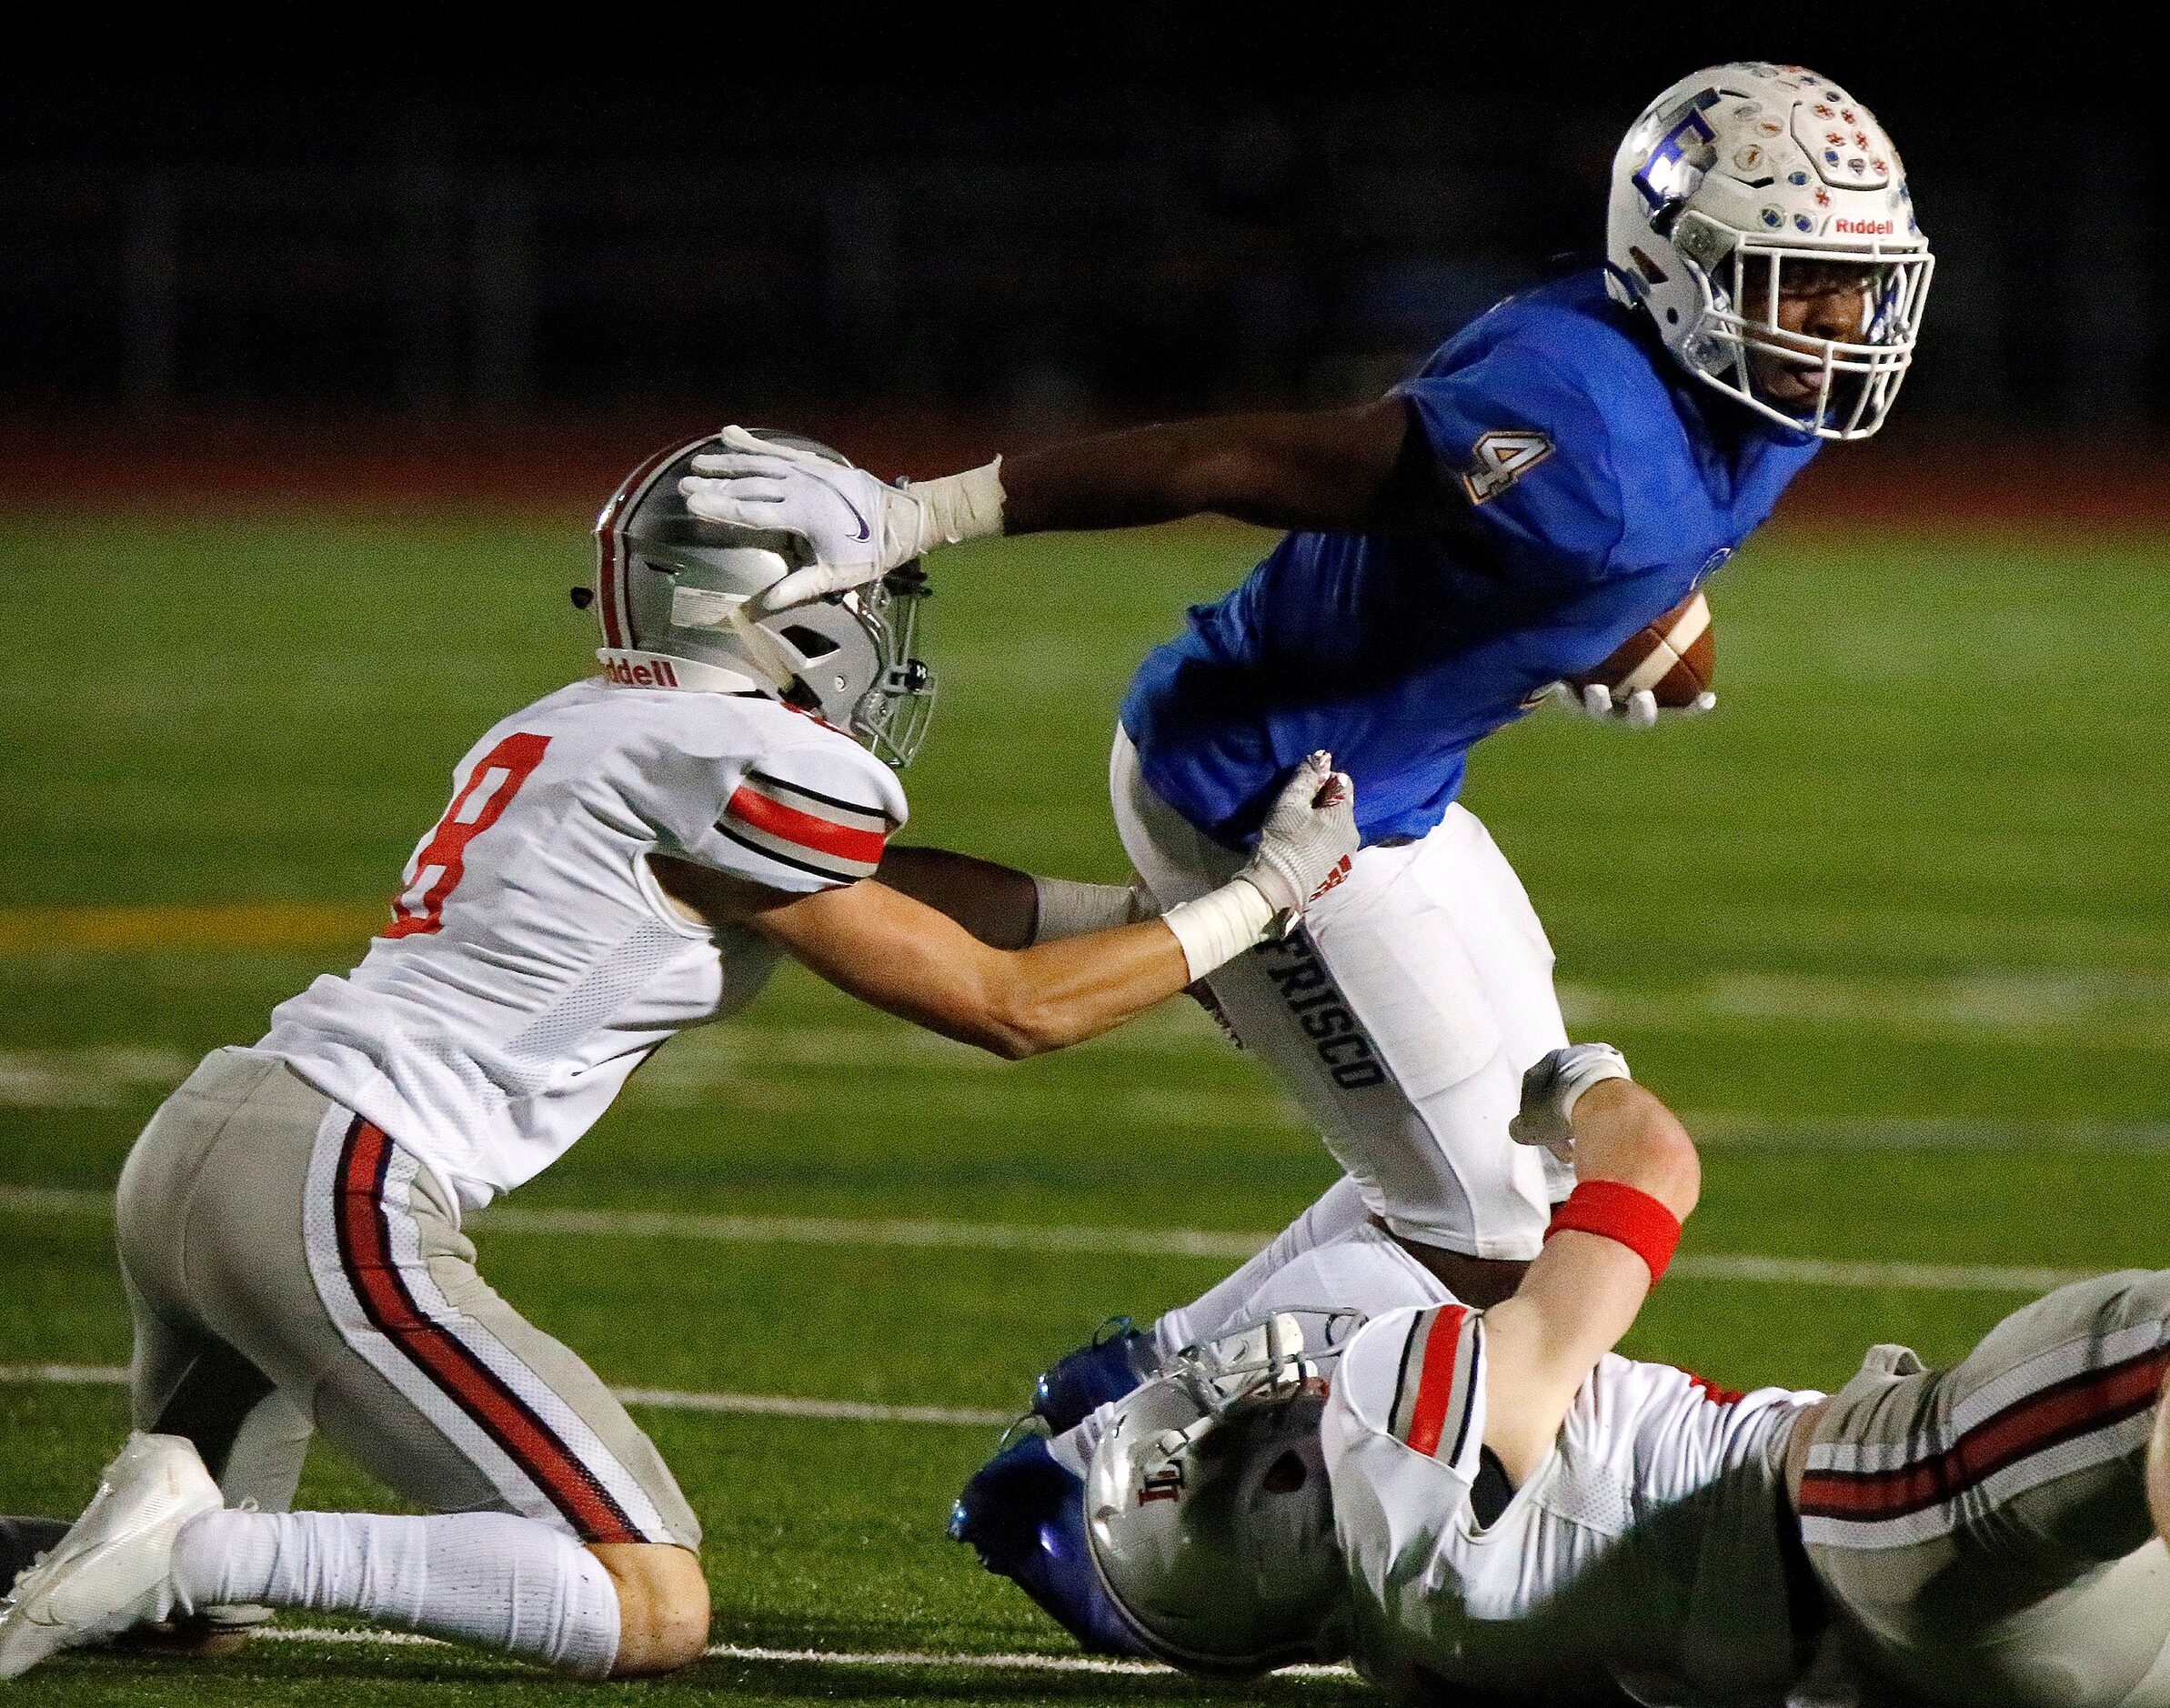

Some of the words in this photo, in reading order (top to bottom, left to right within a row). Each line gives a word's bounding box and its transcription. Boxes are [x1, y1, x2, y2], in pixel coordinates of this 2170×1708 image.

[1835, 218, 1894, 235] Riddell
[1463, 430, 1556, 506] 4
[382, 732, 553, 939] 8
[1253, 928, 1387, 1090] FRISCO
